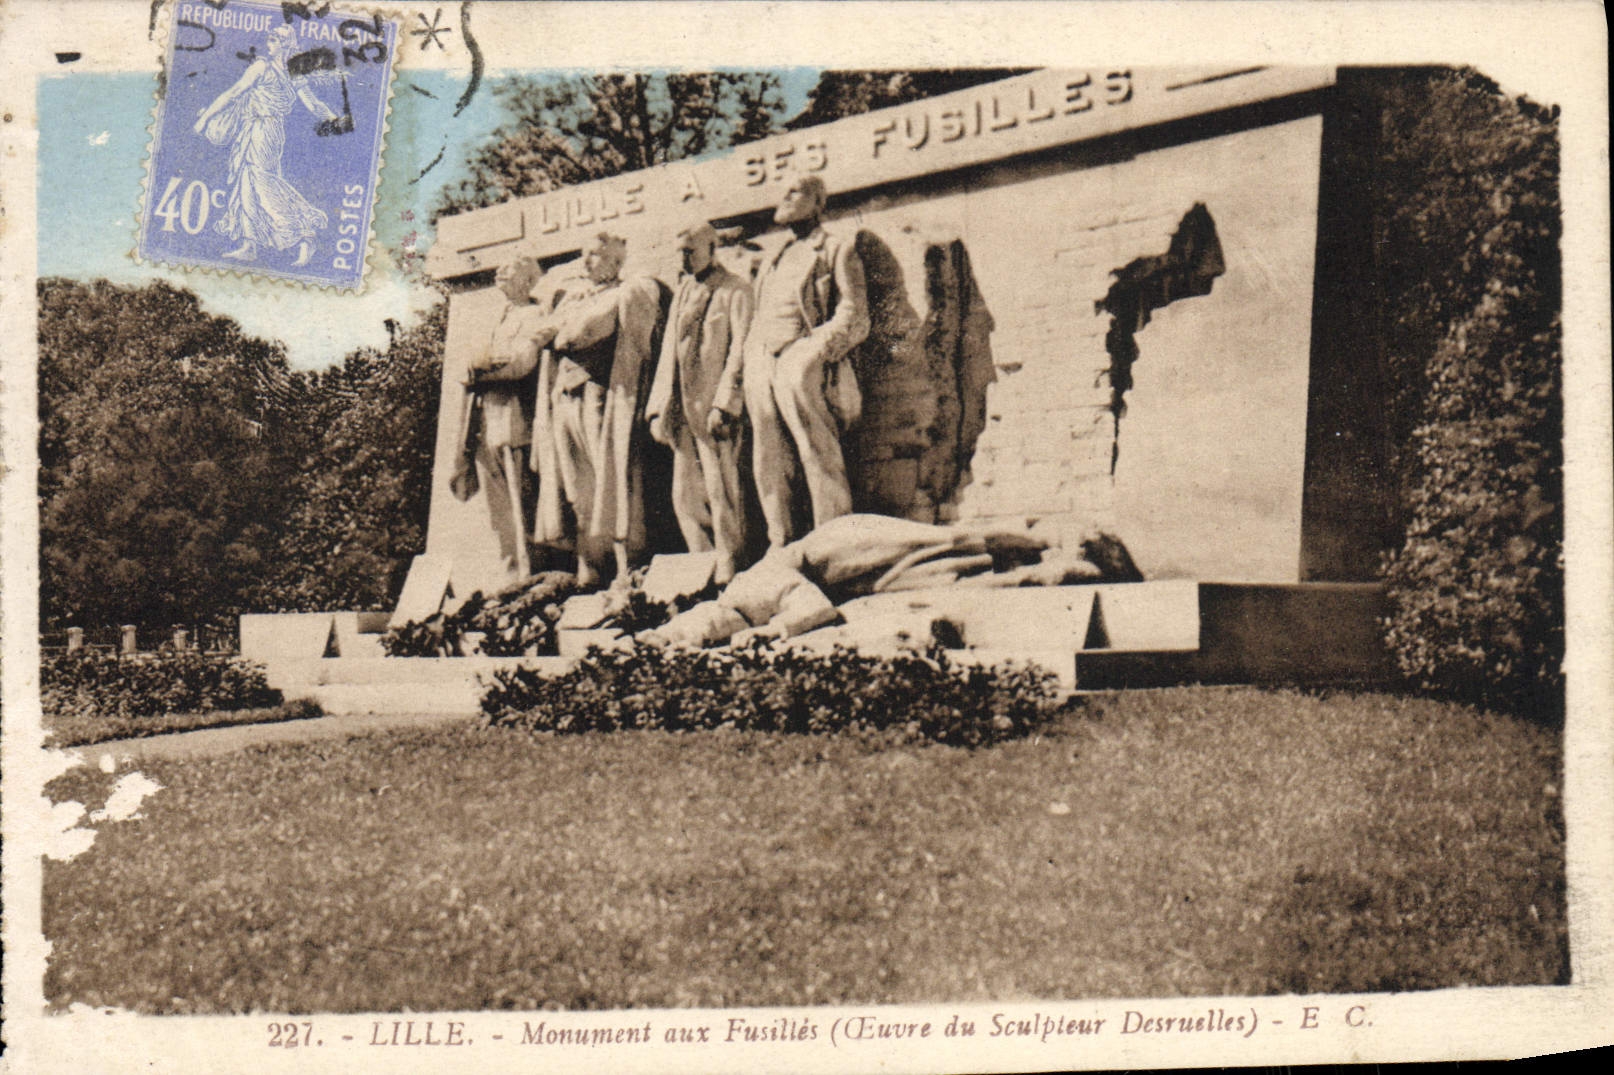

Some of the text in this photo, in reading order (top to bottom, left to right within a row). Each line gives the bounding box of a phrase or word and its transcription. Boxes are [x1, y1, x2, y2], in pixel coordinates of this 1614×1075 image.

[541, 68, 1135, 235] LILLE A SES FUSILLES
[332, 183, 365, 271] POSTES
